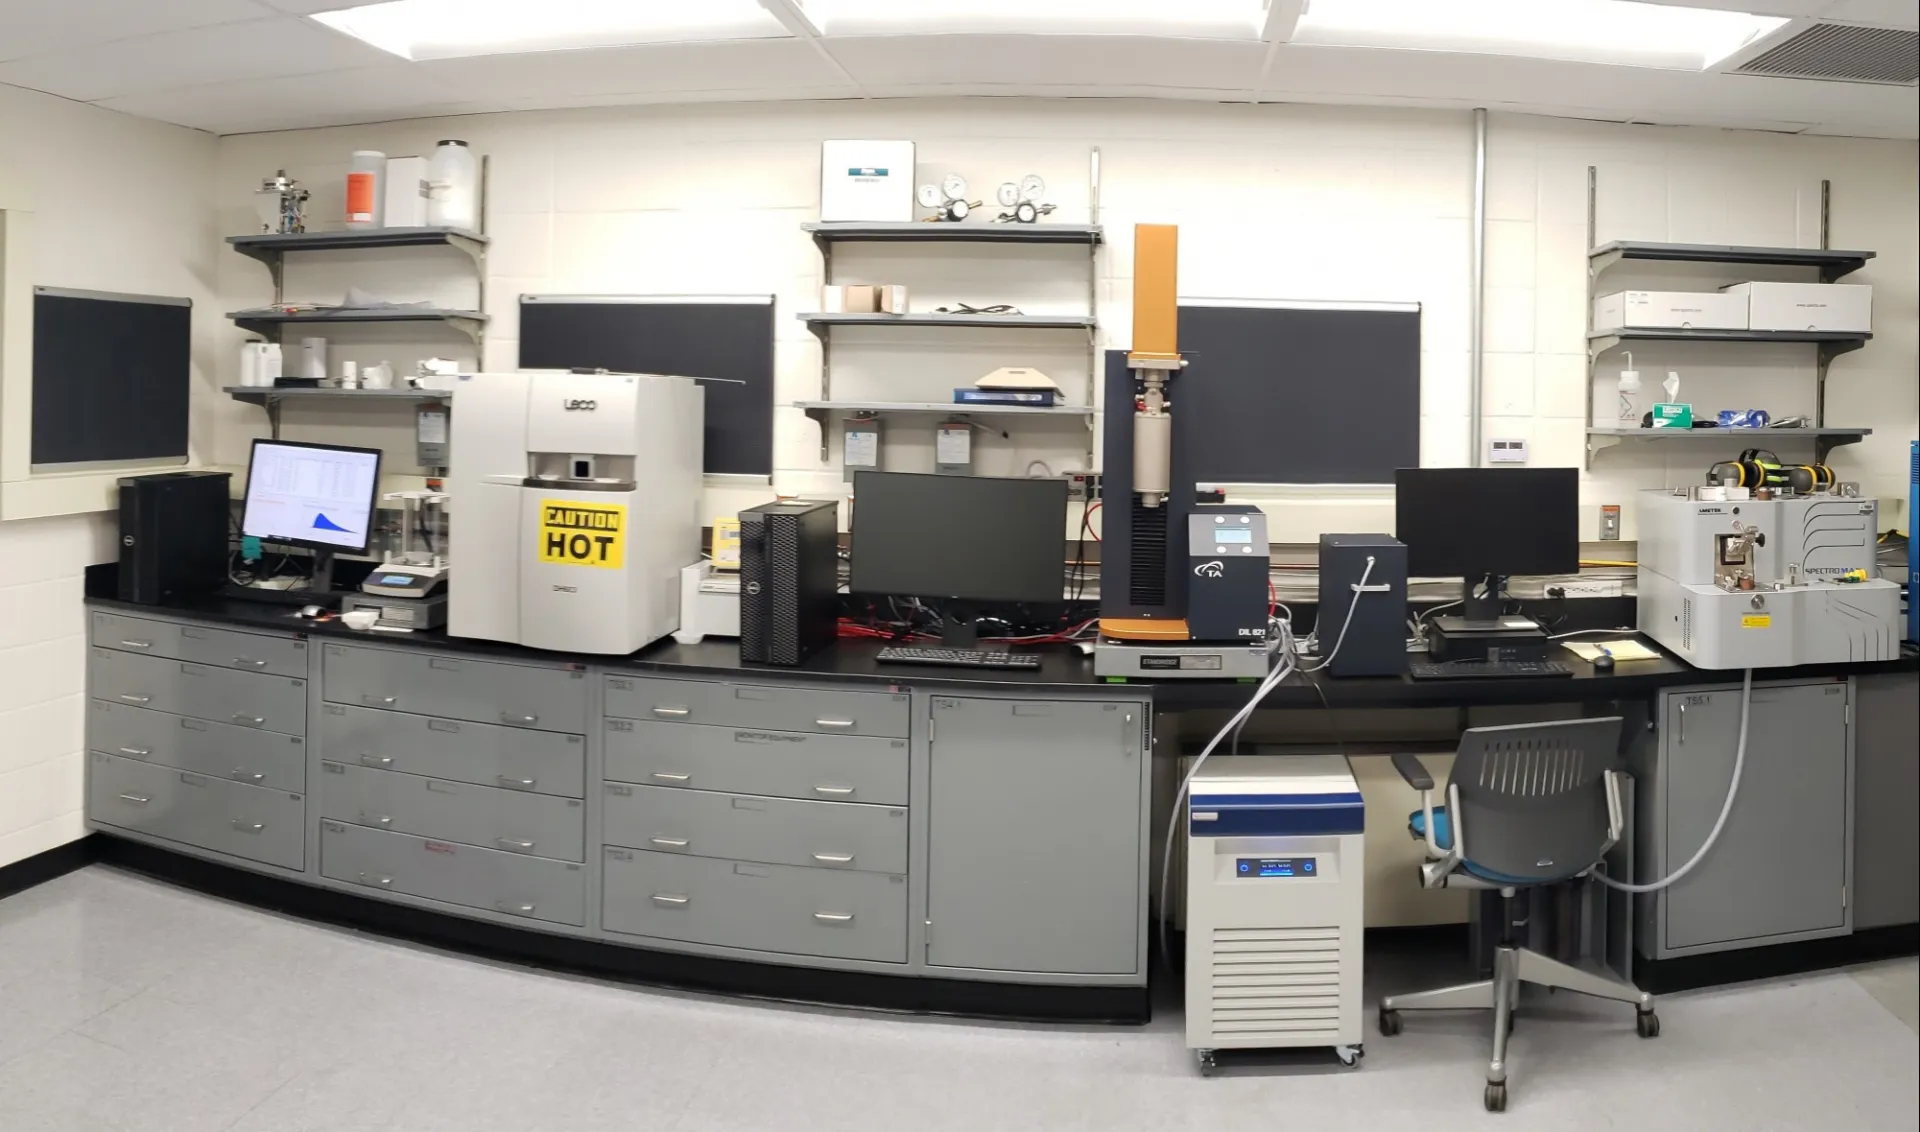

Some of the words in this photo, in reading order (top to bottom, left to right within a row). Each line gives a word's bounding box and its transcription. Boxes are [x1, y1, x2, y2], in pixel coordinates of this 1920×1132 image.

[546, 508, 619, 529] CAUTION
[547, 532, 614, 561] HOT
[1206, 570, 1223, 578] TA
[1238, 628, 1251, 636] DIL
[1686, 696, 1710, 706] TS5.1
